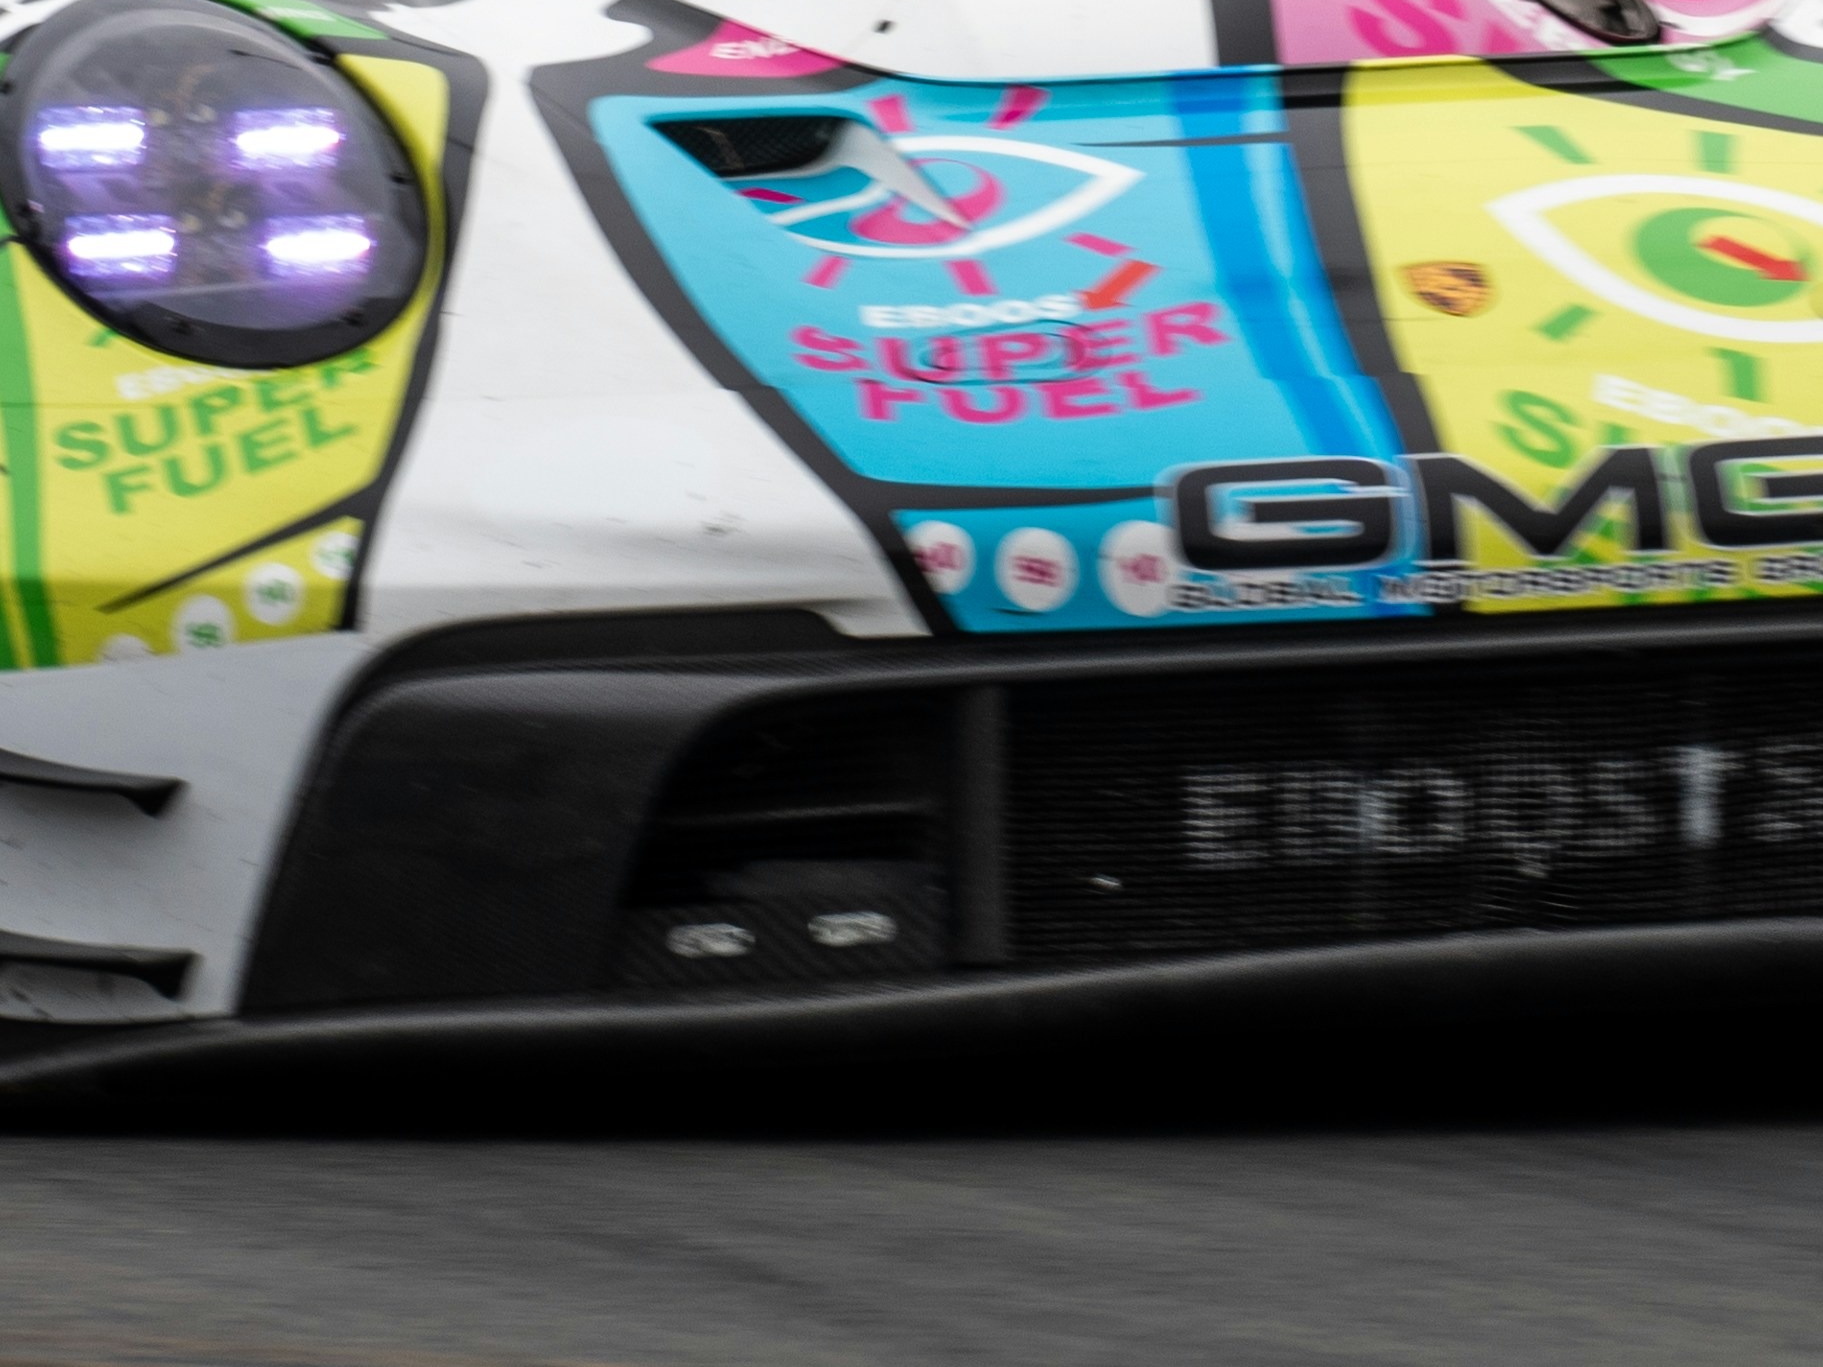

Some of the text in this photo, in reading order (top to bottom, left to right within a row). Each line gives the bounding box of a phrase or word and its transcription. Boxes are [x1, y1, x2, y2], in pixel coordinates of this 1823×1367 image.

[859, 294, 1084, 329] EBOOS
[787, 301, 1232, 385] SUPER
[104, 408, 358, 515] FUEL
[1166, 572, 1366, 613] GLOBAL
